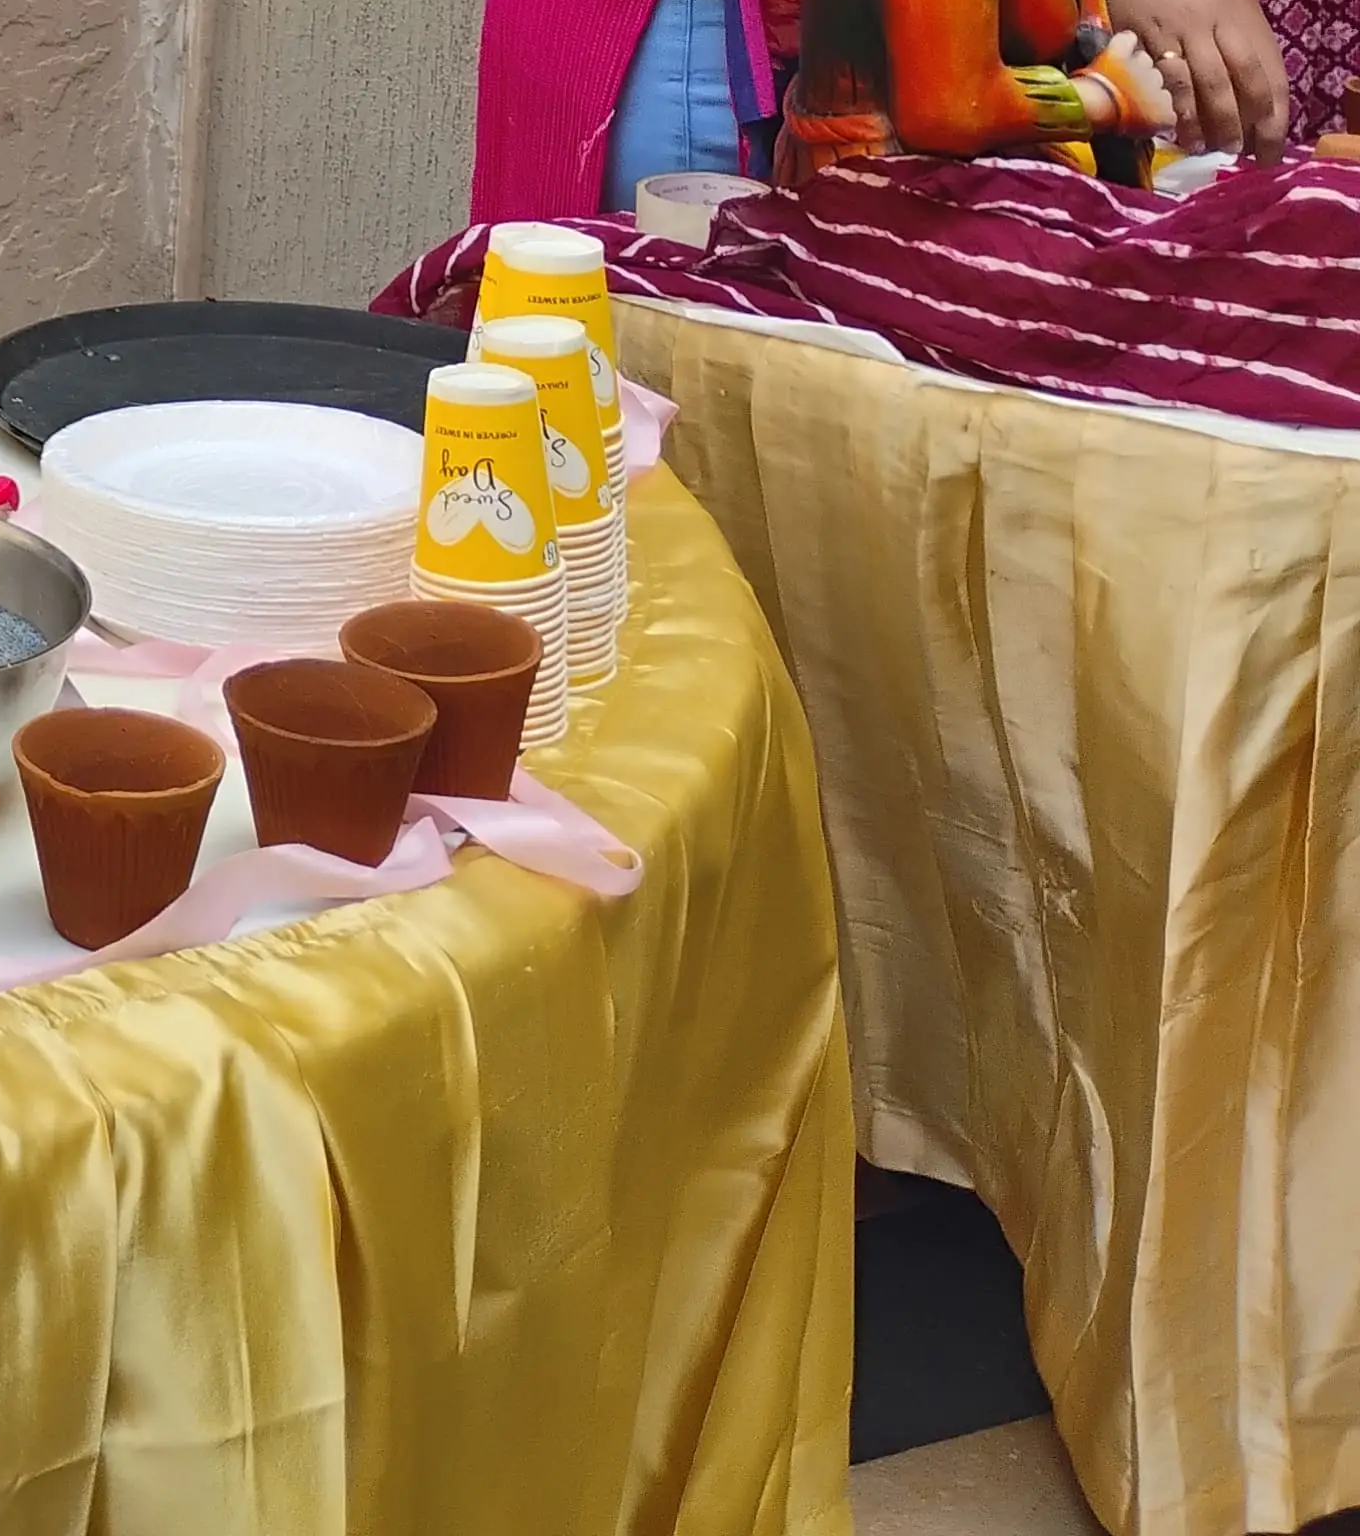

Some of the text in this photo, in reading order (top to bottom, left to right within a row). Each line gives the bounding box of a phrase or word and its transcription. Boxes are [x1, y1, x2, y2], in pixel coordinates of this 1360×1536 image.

[560, 296, 570, 305] IN
[536, 381, 569, 391] FOREVE
[463, 431, 474, 440] IN
[476, 429, 517, 440] FOREVER
[439, 449, 495, 492] Day
[439, 490, 513, 521] Sweet
